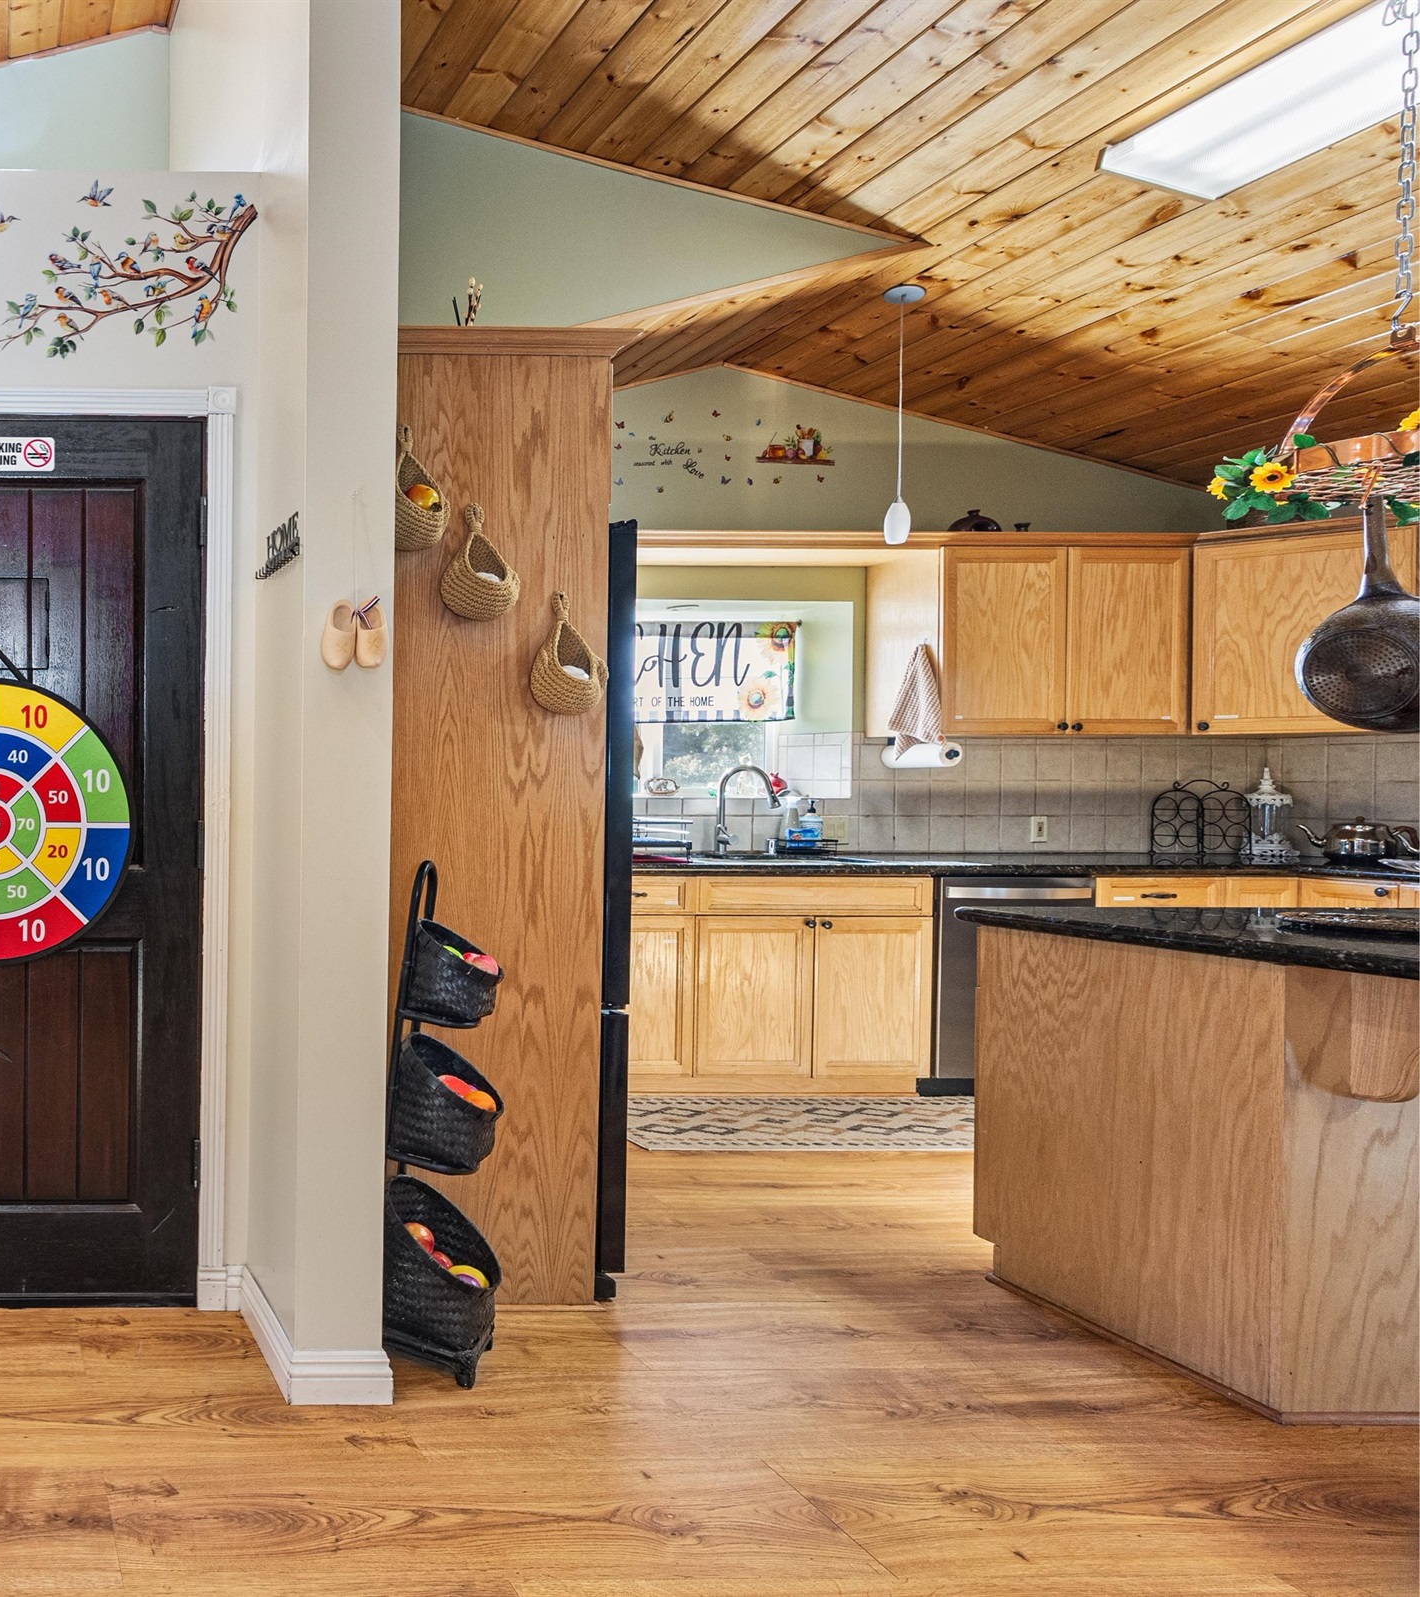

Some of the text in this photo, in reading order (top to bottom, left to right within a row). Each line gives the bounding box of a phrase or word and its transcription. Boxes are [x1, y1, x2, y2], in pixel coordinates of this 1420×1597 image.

[649, 441, 690, 456] Kitchen
[682, 458, 704, 479] Love
[651, 696, 662, 707] OF
[667, 696, 685, 707] THE
[689, 696, 714, 707] HOME
[21, 705, 48, 728] 10
[8, 750, 28, 764] 40
[82, 768, 110, 793] 10
[48, 790, 68, 804] 50
[17, 818, 35, 831] 70
[48, 845, 68, 858] 20
[82, 857, 110, 881] 10
[7, 884, 27, 898] 50
[18, 919, 45, 942] 10
